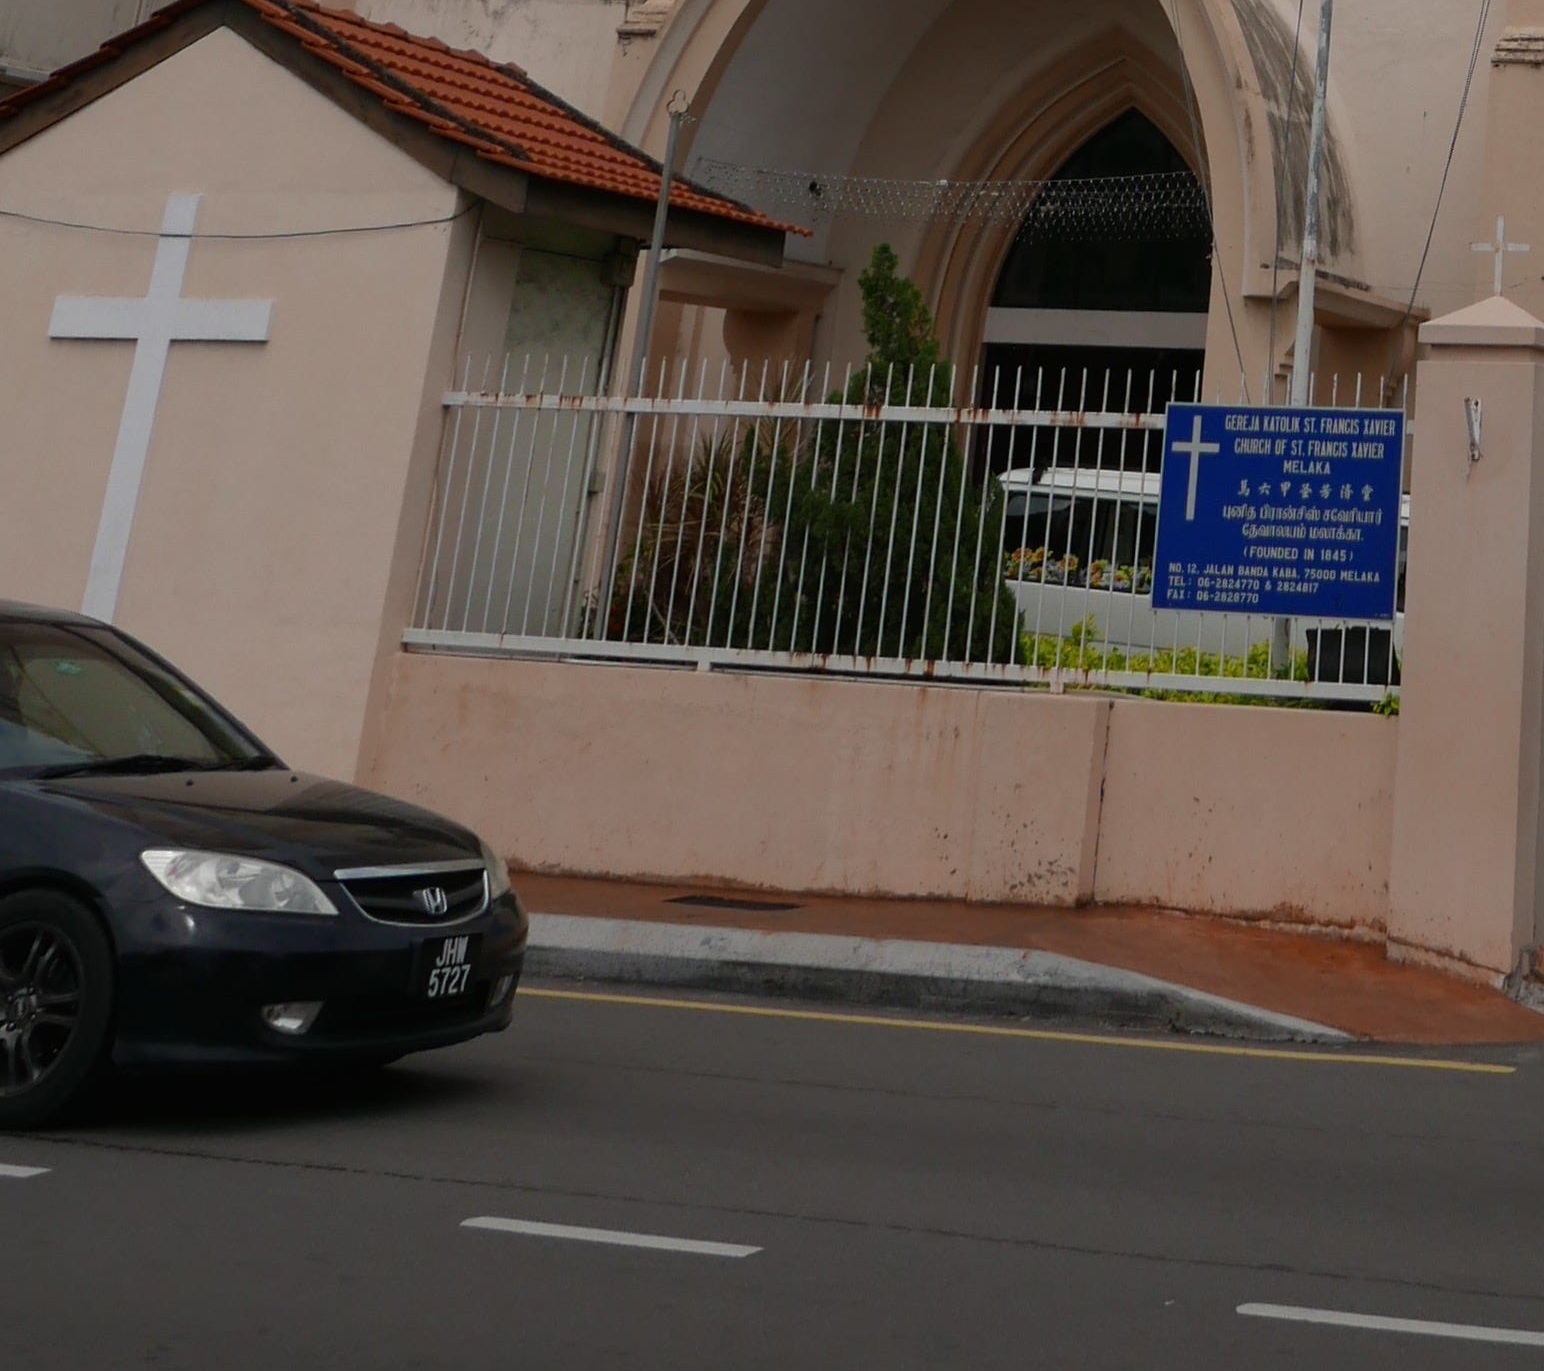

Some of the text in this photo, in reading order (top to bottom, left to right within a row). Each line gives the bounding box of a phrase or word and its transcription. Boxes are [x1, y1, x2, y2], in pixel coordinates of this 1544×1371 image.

[1225, 414, 1396, 437] GEREJA KATOLIK ST. FRANCIS XAVIER
[1234, 438, 1271, 455] CHURCH
[1275, 439, 1288, 456] OF
[1307, 440, 1348, 458] FRANCIS
[1351, 441, 1385, 459] XAVIER
[1283, 460, 1331, 476] MELAKA
[1303, 547, 1315, 561] IN
[1203, 563, 1235, 576] JALAN
[1238, 564, 1269, 577] BANDA
[1304, 567, 1337, 580] 75000
[1340, 568, 1380, 583] MELAKA
[436, 935, 469, 967] JHW
[427, 963, 471, 998] 5727
